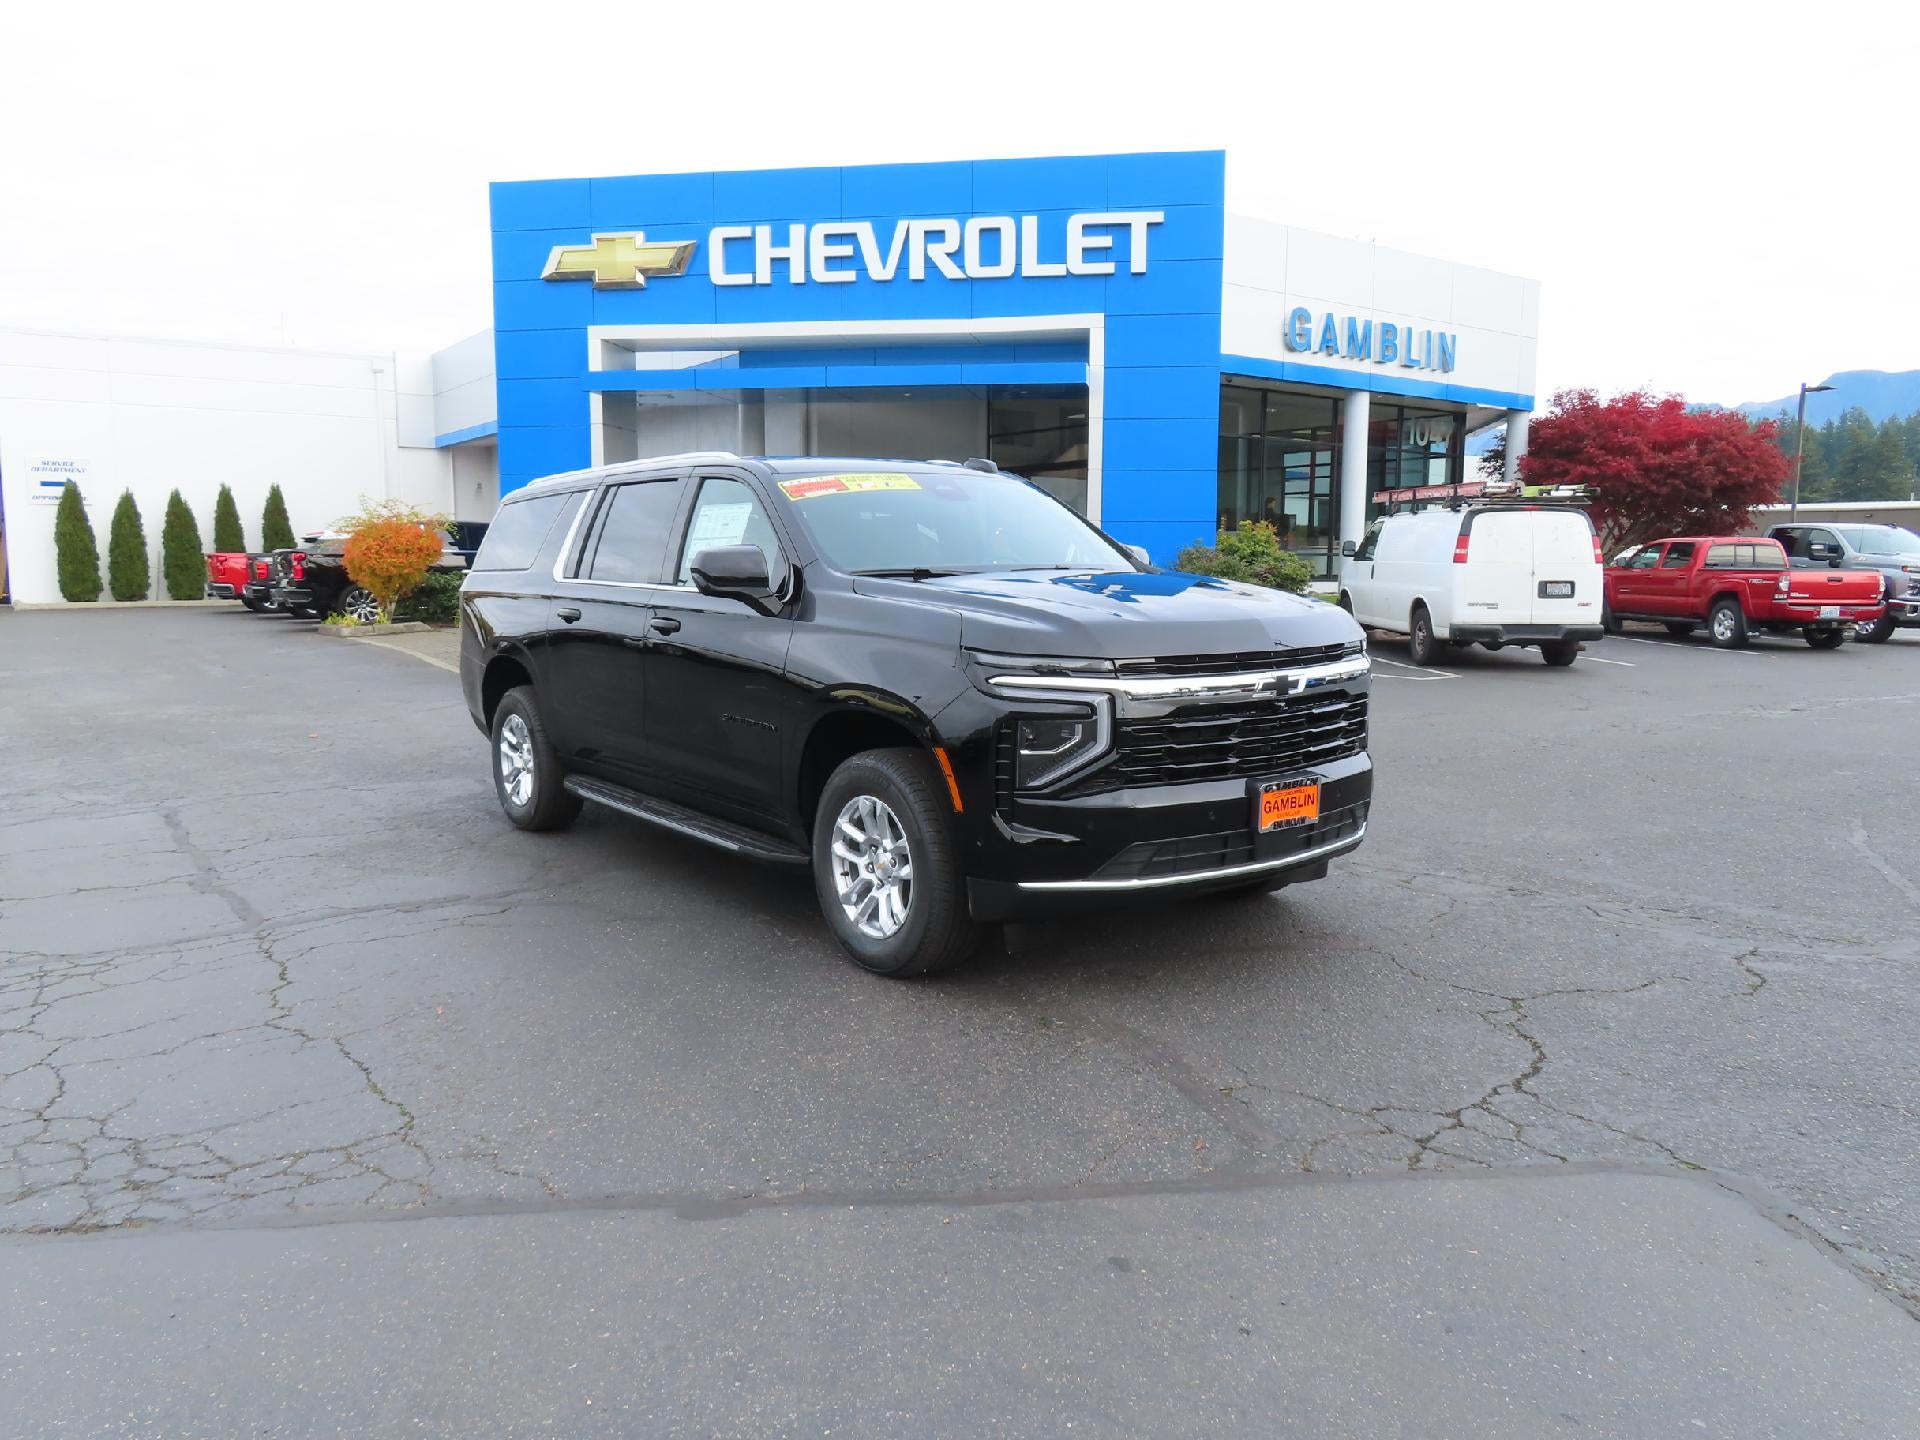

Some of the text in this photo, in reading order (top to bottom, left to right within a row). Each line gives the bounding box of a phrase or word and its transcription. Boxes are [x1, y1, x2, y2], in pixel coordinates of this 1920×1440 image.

[708, 210, 1165, 286] CHEVROLET
[1284, 306, 1457, 374] GAMBLIN
[1264, 793, 1315, 813] GAMBLIN
